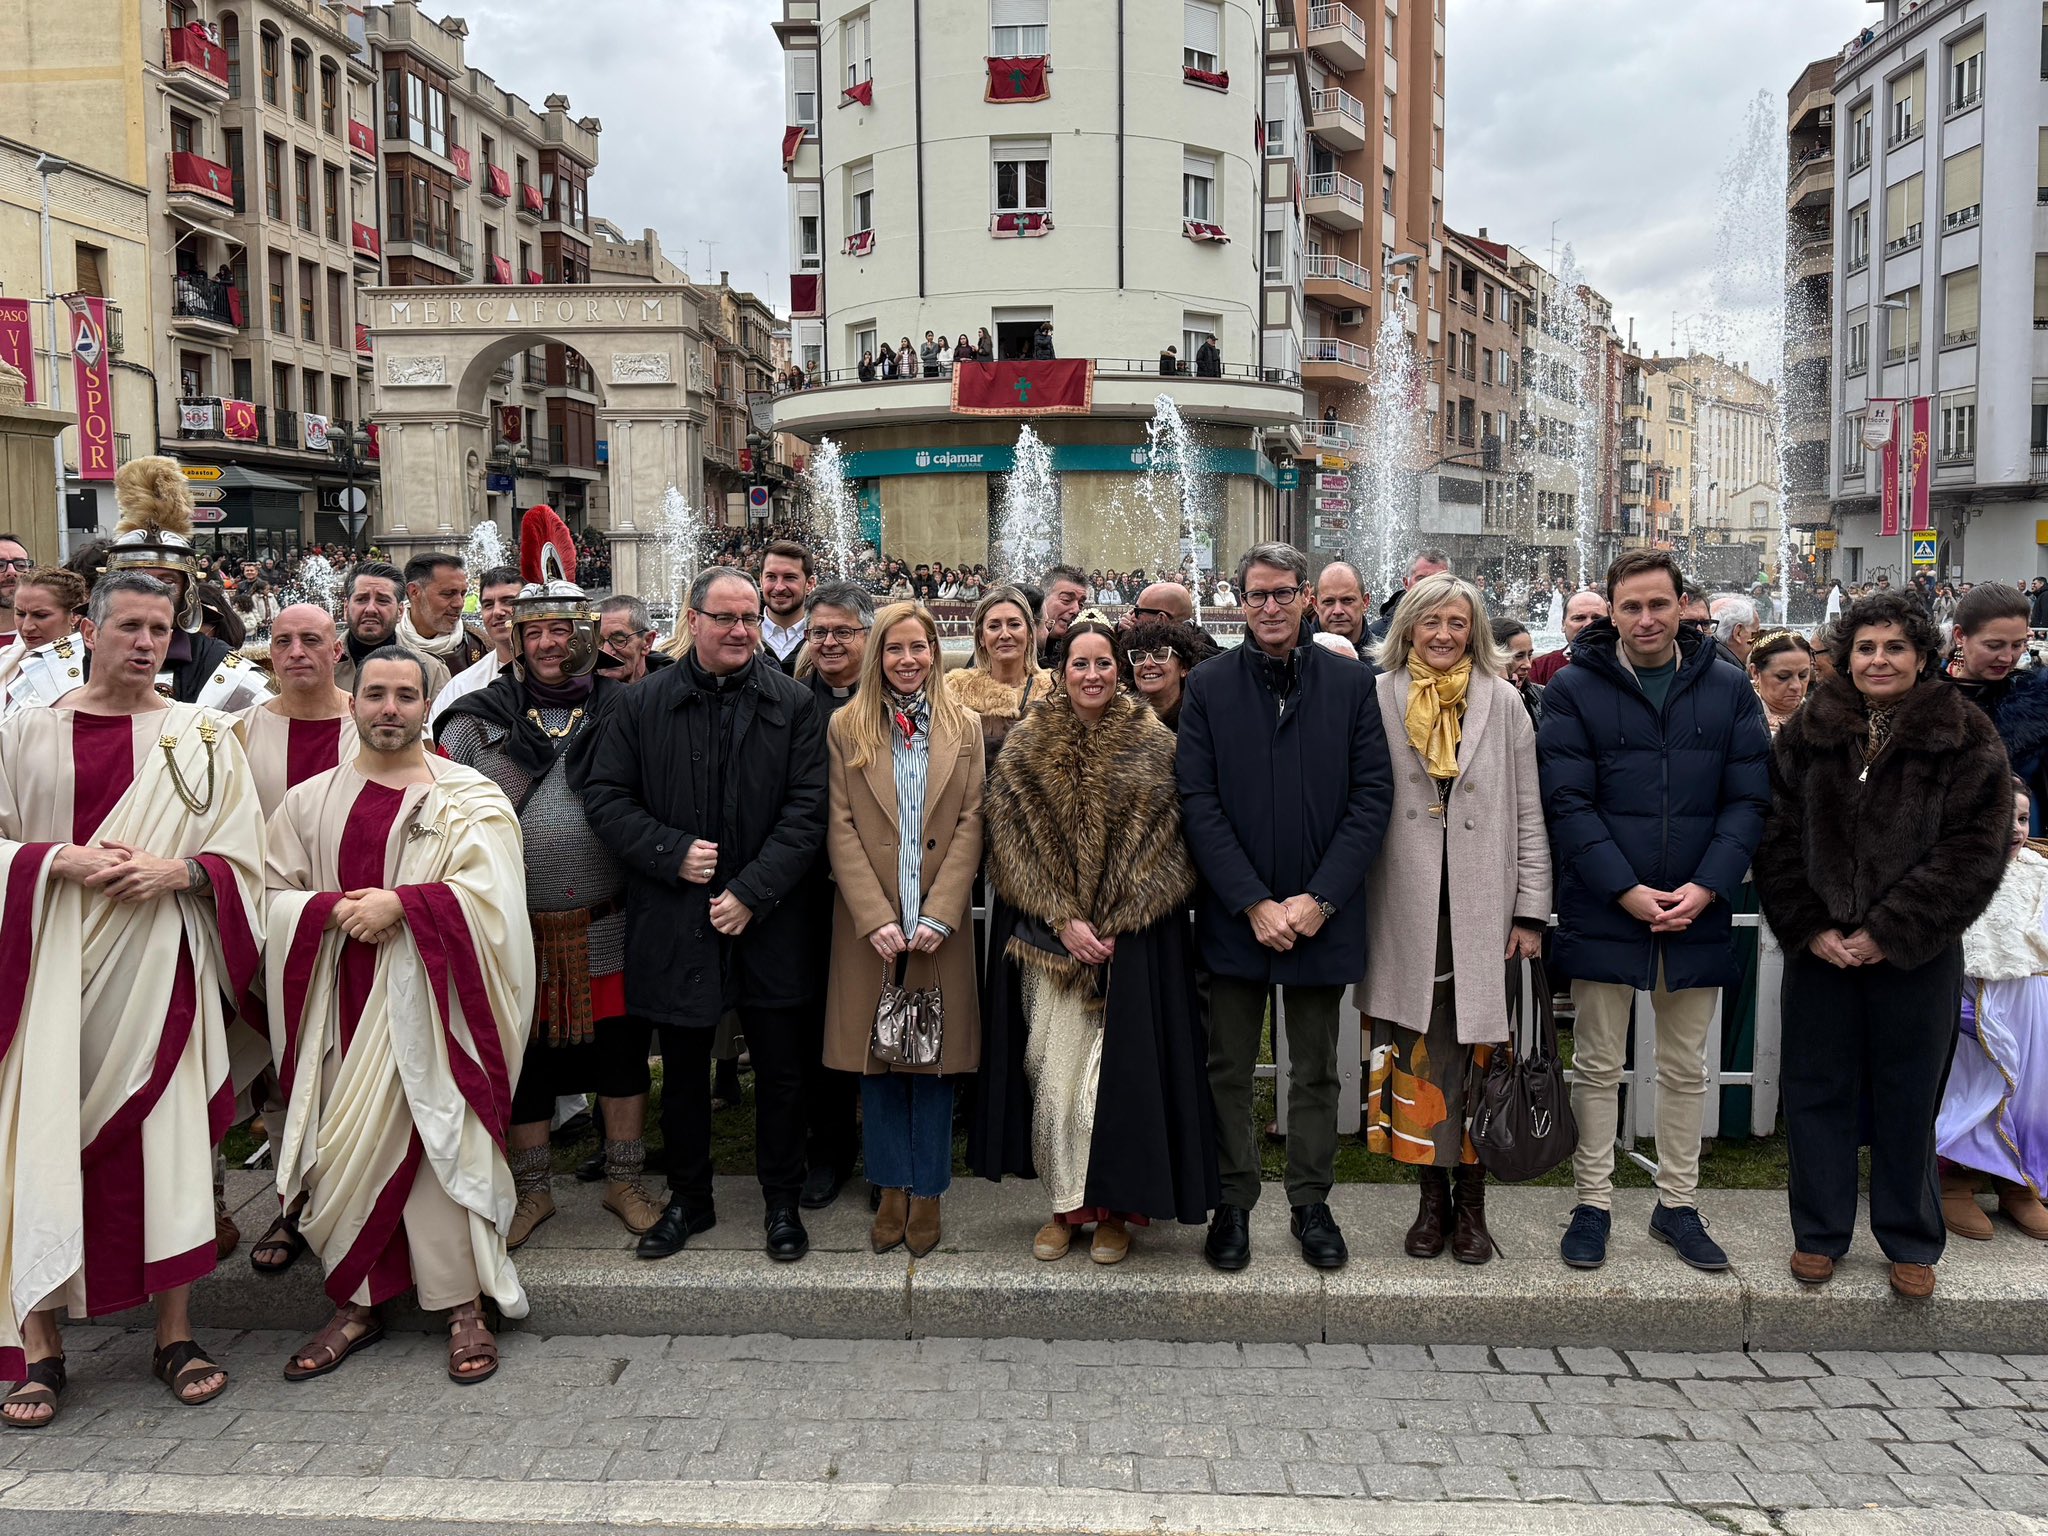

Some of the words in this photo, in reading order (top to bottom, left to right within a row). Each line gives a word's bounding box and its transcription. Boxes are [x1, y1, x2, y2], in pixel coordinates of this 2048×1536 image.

[390, 300, 663, 324] MERCAFORVM
[86, 366, 108, 468] SPQR
[933, 451, 983, 467] cajamar
